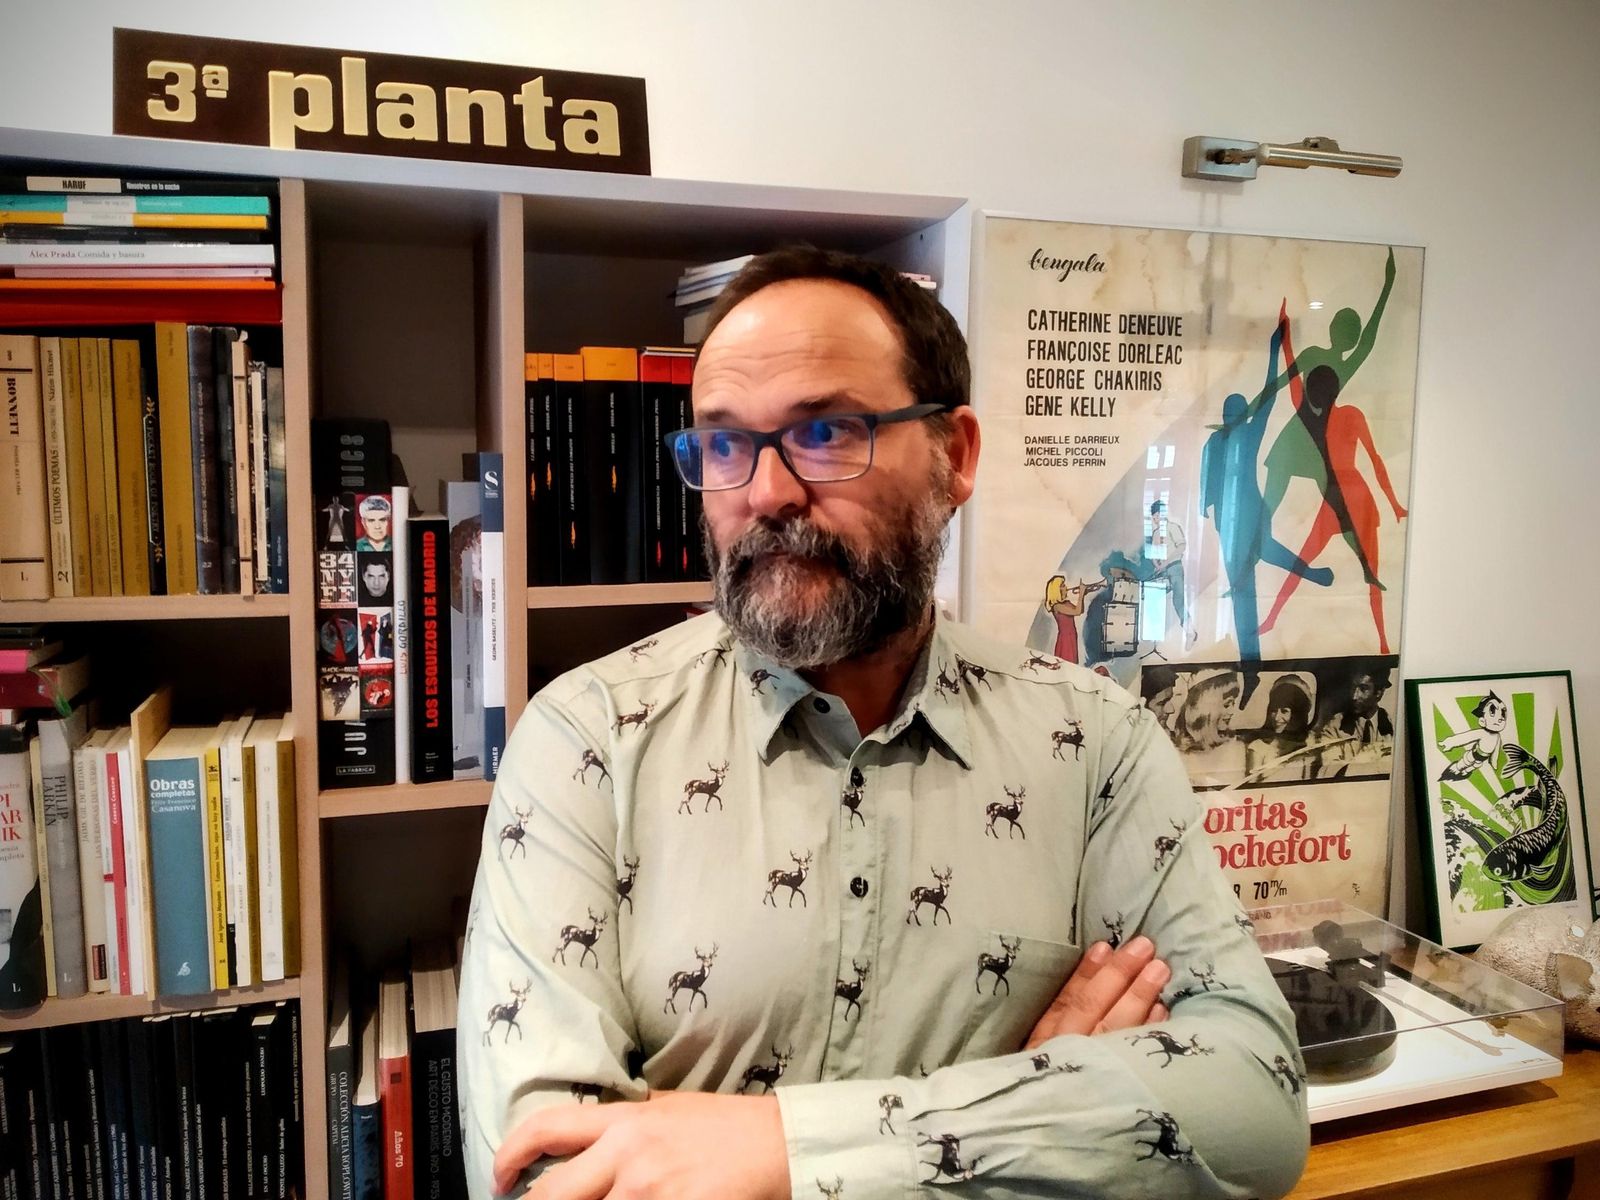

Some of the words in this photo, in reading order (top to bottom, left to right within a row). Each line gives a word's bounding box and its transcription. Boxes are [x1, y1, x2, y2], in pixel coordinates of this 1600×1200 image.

[146, 60, 229, 123] 3ª
[268, 56, 621, 157] planta
[62, 180, 87, 190] HARUF
[50, 250, 76, 258] Prada
[1030, 248, 1107, 283] bengala
[1028, 308, 1112, 334] CATHERINE
[1118, 314, 1183, 337] DENEUVE
[1027, 340, 1112, 364] FRANÇOISE
[1118, 342, 1183, 366] DORLEAC
[1026, 368, 1086, 390] GEORGE
[1094, 370, 1162, 392] CHAKIRIS
[6, 378, 19, 436] BONNETT
[1025, 395, 1063, 417] GENE
[1070, 396, 1117, 418] KELLY
[1024, 436, 1070, 445] DANIELLE
[1074, 436, 1120, 444] DARRIEUX
[1026, 447, 1062, 456] MICHEL
[1065, 448, 1103, 456] PICCOLI
[50, 450, 61, 485] POEMAS
[1024, 458, 1069, 468] JACQUES
[1072, 458, 1106, 467] PERRIN
[320, 553, 354, 568] 34
[422, 531, 436, 594] MADRID
[320, 569, 354, 585] NY
[424, 596, 436, 616] DE
[397, 600, 408, 649] GORDILLO
[398, 652, 408, 675] LUIS
[424, 620, 438, 694] ESQUIZOS
[426, 698, 439, 728] LOS
[150, 779, 195, 791] Obras
[150, 790, 196, 798] completas
[42, 776, 57, 826] LARKIN
[54, 776, 69, 820] PHILIP
[151, 805, 196, 813] Casanova
[1202, 794, 1308, 834] oritas
[216, 914, 225, 932] Ignacio
[428, 1060, 439, 1076] ART
[440, 1058, 451, 1070] EL
[339, 1071, 350, 1123] COLECCIÓN
[440, 1072, 452, 1105] GUSTO
[429, 1110, 439, 1124] EN
[340, 1124, 351, 1156] ALICIA
[394, 1130, 403, 1154] Años
[440, 1106, 452, 1158] MODERNO
[395, 1155, 404, 1168] 70
